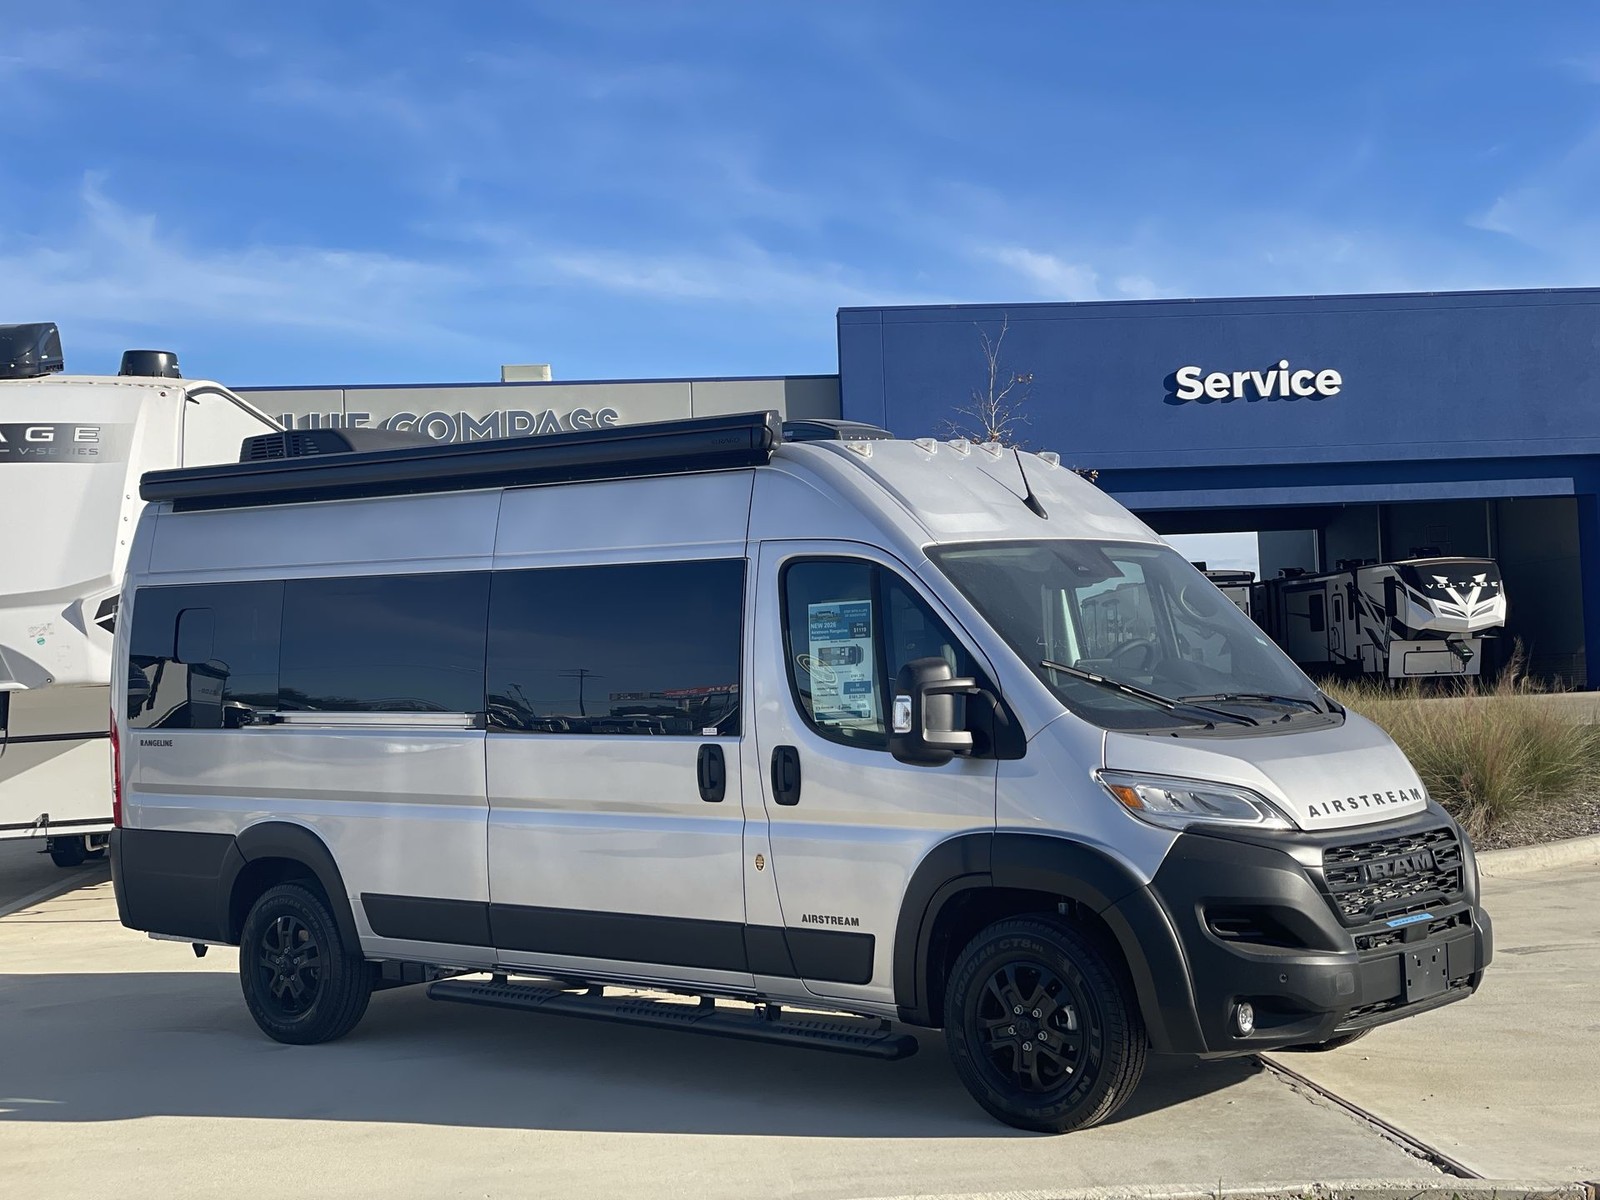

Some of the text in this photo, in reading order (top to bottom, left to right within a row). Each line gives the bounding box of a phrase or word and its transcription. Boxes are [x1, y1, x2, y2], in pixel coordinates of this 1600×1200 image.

[1176, 359, 1343, 400] Service
[1425, 581, 1499, 589] VOLTAGE
[140, 739, 173, 747] RANGELINE
[1308, 788, 1422, 817] AIRSTREAM
[1369, 853, 1435, 880] RAM
[801, 914, 860, 926] AIRSTREAM
[1025, 1075, 1092, 1118] NEXEN
